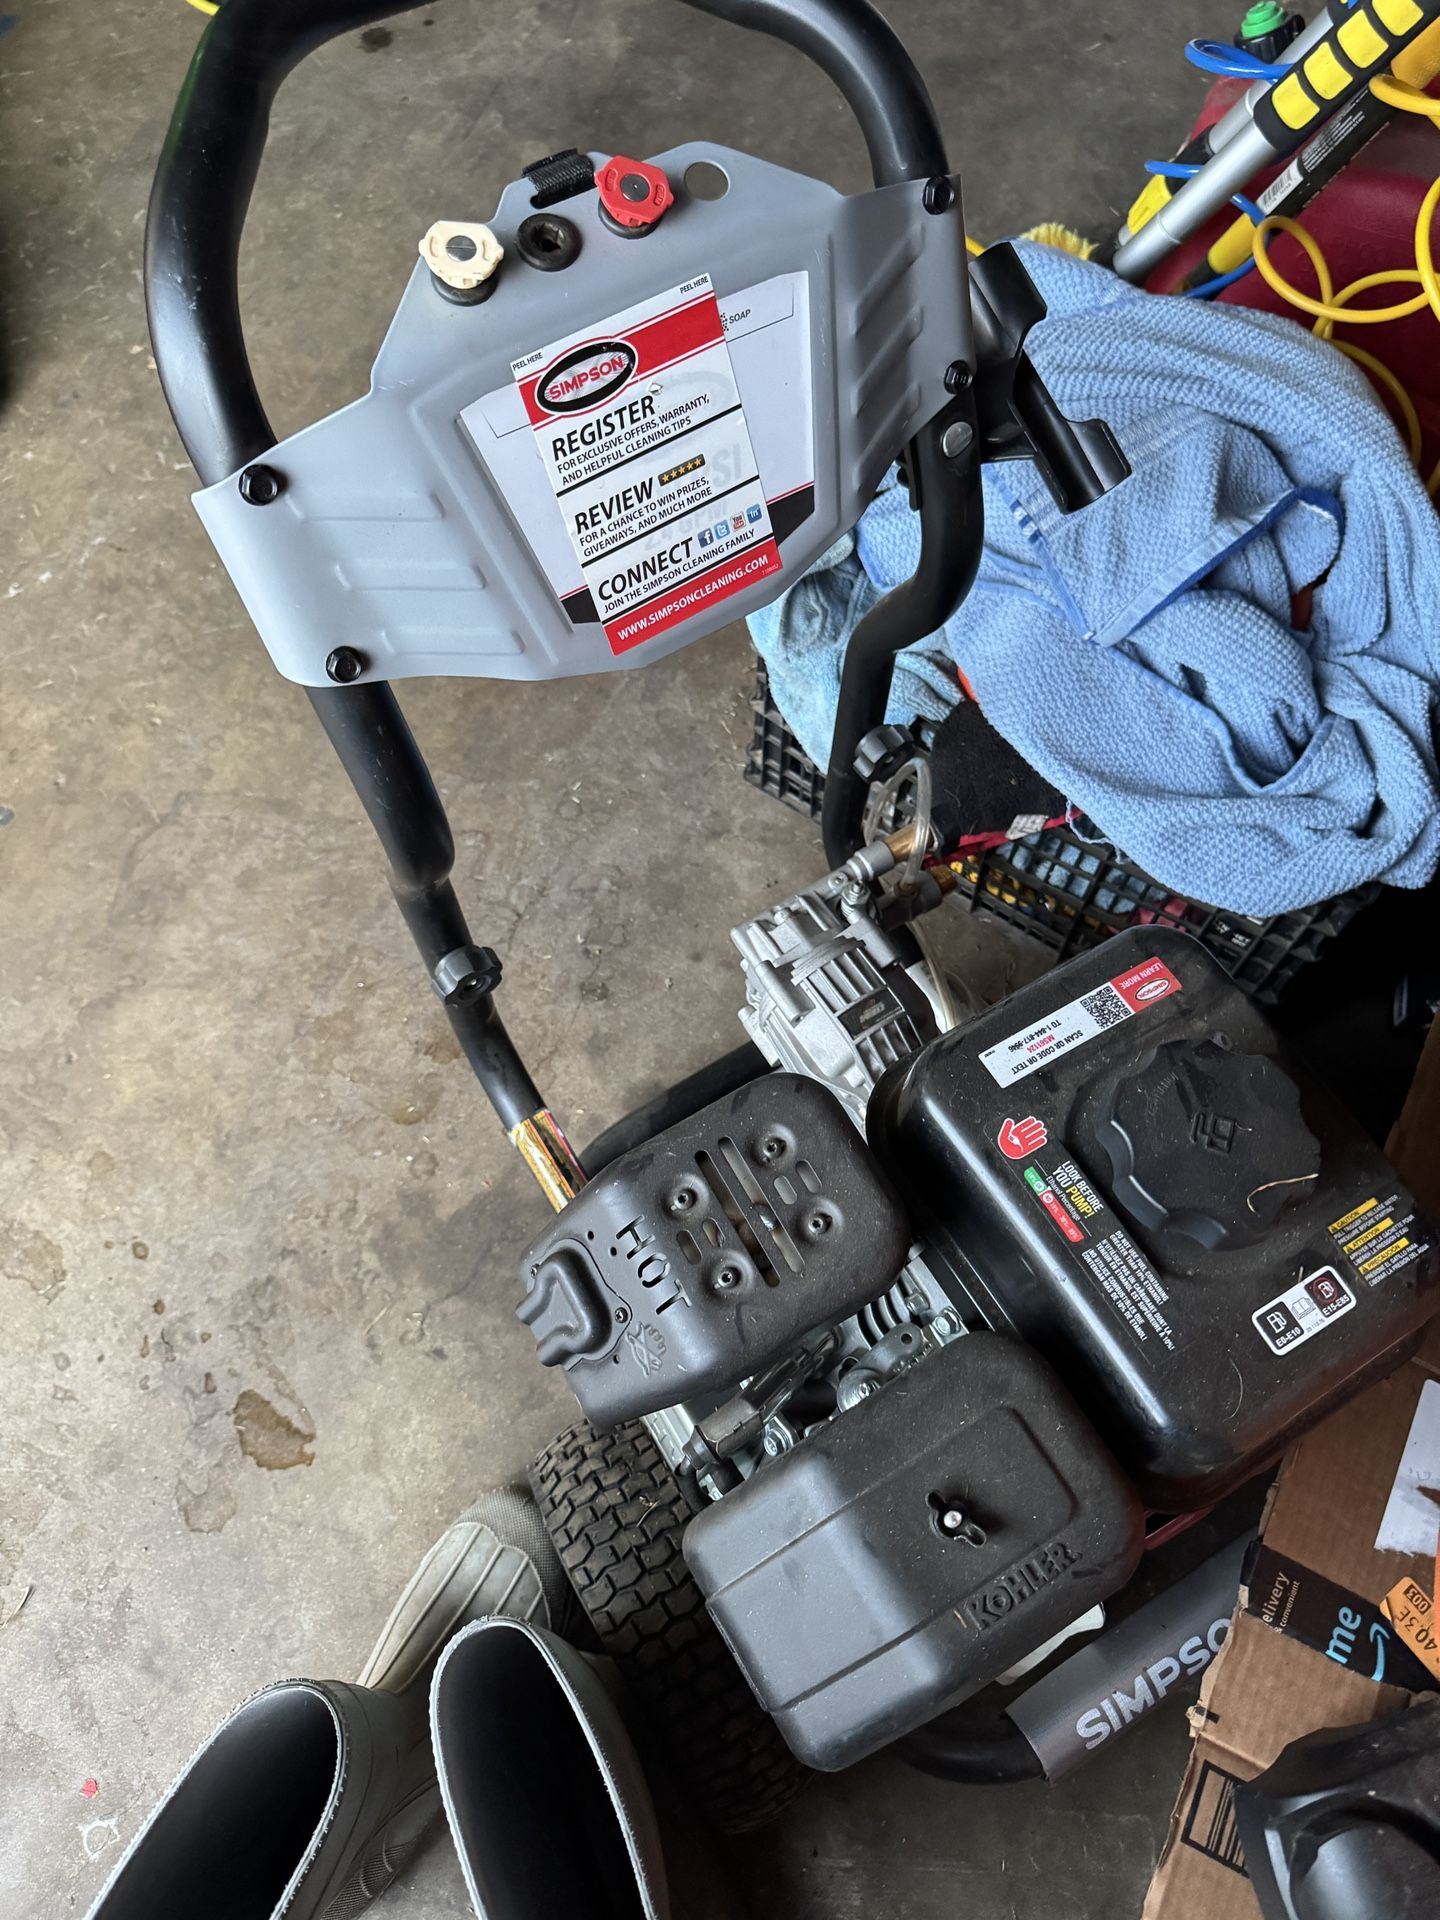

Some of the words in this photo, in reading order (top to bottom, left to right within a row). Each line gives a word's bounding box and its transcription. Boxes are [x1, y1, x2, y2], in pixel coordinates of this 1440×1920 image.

[678, 281, 694, 296] PEEL
[692, 274, 709, 290] HERE
[729, 308, 751, 324] SOAP
[511, 357, 529, 372] PEEL
[526, 350, 544, 365] HERE
[548, 354, 625, 401] SIMPSON
[551, 392, 655, 462] REGISTER
[556, 457, 577, 474] FOR
[575, 434, 624, 464] EXCLUSIVE
[622, 417, 659, 442] OFFERS,
[658, 392, 709, 425] WARRANTY,
[560, 467, 583, 486] AND
[582, 447, 625, 475] HELPFUL
[624, 424, 671, 455] CLEANING
[670, 414, 692, 432] TIPS
[574, 476, 654, 535] REVIEW
[578, 530, 599, 546] FOR
[598, 526, 607, 537] A
[606, 507, 644, 533] CHANCE
[643, 500, 657, 514] TO
[656, 491, 676, 508] WIN
[675, 474, 709, 498] PRIZES,
[582, 524, 637, 558] GIVEAWAYS,
[636, 513, 658, 530] AND
[657, 499, 686, 520] MUCH
[685, 485, 712, 506] MORE
[597, 537, 695, 603] CONNECT
[602, 596, 625, 614] JOIN
[623, 586, 642, 602] THE
[641, 566, 682, 593] SIMPSON
[681, 543, 725, 573] CLEANING
[724, 527, 756, 550] FAMILY
[616, 552, 769, 642] WWW.SIMPSONCLEANING.COM
[1117, 973, 1141, 990] MORE
[1137, 961, 1163, 979] LEARN
[1049, 1018, 1062, 1029] TO
[1052, 1039, 1066, 1050] QR
[1061, 1028, 1084, 1045] SCAN
[1009, 1059, 1029, 1075] TEXT
[1025, 1054, 1038, 1066] OR
[1034, 1044, 1056, 1060] CODE
[1045, 1174, 1063, 1195] Ethanol
[1057, 1192, 1082, 1222] Percentage
[1050, 1165, 1073, 1189] YOU
[1064, 1184, 1095, 1220] PUMP!
[1060, 1159, 1083, 1183] LOOK
[1075, 1179, 1105, 1213] BEFORE
[1335, 1208, 1360, 1228] CAUTION
[1351, 1226, 1380, 1248] ATTENTION
[616, 1215, 692, 1315] HOT
[1080, 1250, 1105, 1281] CONTENGAN
[1109, 1291, 1119, 1301] DE
[1115, 1299, 1127, 1312] 10%
[1122, 1310, 1133, 1320] DE
[1093, 1256, 1111, 1277] UTILICE
[1106, 1275, 1137, 1314] COMBUSTIBLES
[1132, 1312, 1144, 1325] QUE
[1094, 1241, 1112, 1263] TENEUR
[1107, 1260, 1118, 1270] EN
[1129, 1290, 1141, 1302] EST
[1108, 1232, 1129, 1257] GREATER
[1124, 1254, 1138, 1270] THAN
[1134, 1268, 1147, 1282] 10%
[1141, 1279, 1164, 1306] ETHANOL!
[1114, 1229, 1124, 1239] DO
[1120, 1237, 1131, 1249] NOT
[1127, 1247, 1139, 1259] USE
[1134, 1257, 1148, 1272] FUEL
[1143, 1270, 1169, 1301] CONTAINING
[1119, 1264, 1131, 1277] PAS
[1126, 1274, 1136, 1284] UN
[1153, 1311, 1167, 1327] DONT
[1163, 1325, 1173, 1335] LA
[1322, 1294, 1350, 1316] E15-E85
[1275, 1326, 1301, 1347] E0-E10
[966, 1540, 1078, 1630] KOHLER
[1262, 1571, 1289, 1626] elivery
[1280, 1580, 1301, 1626] convenient
[1406, 1585, 1429, 1613] 003
